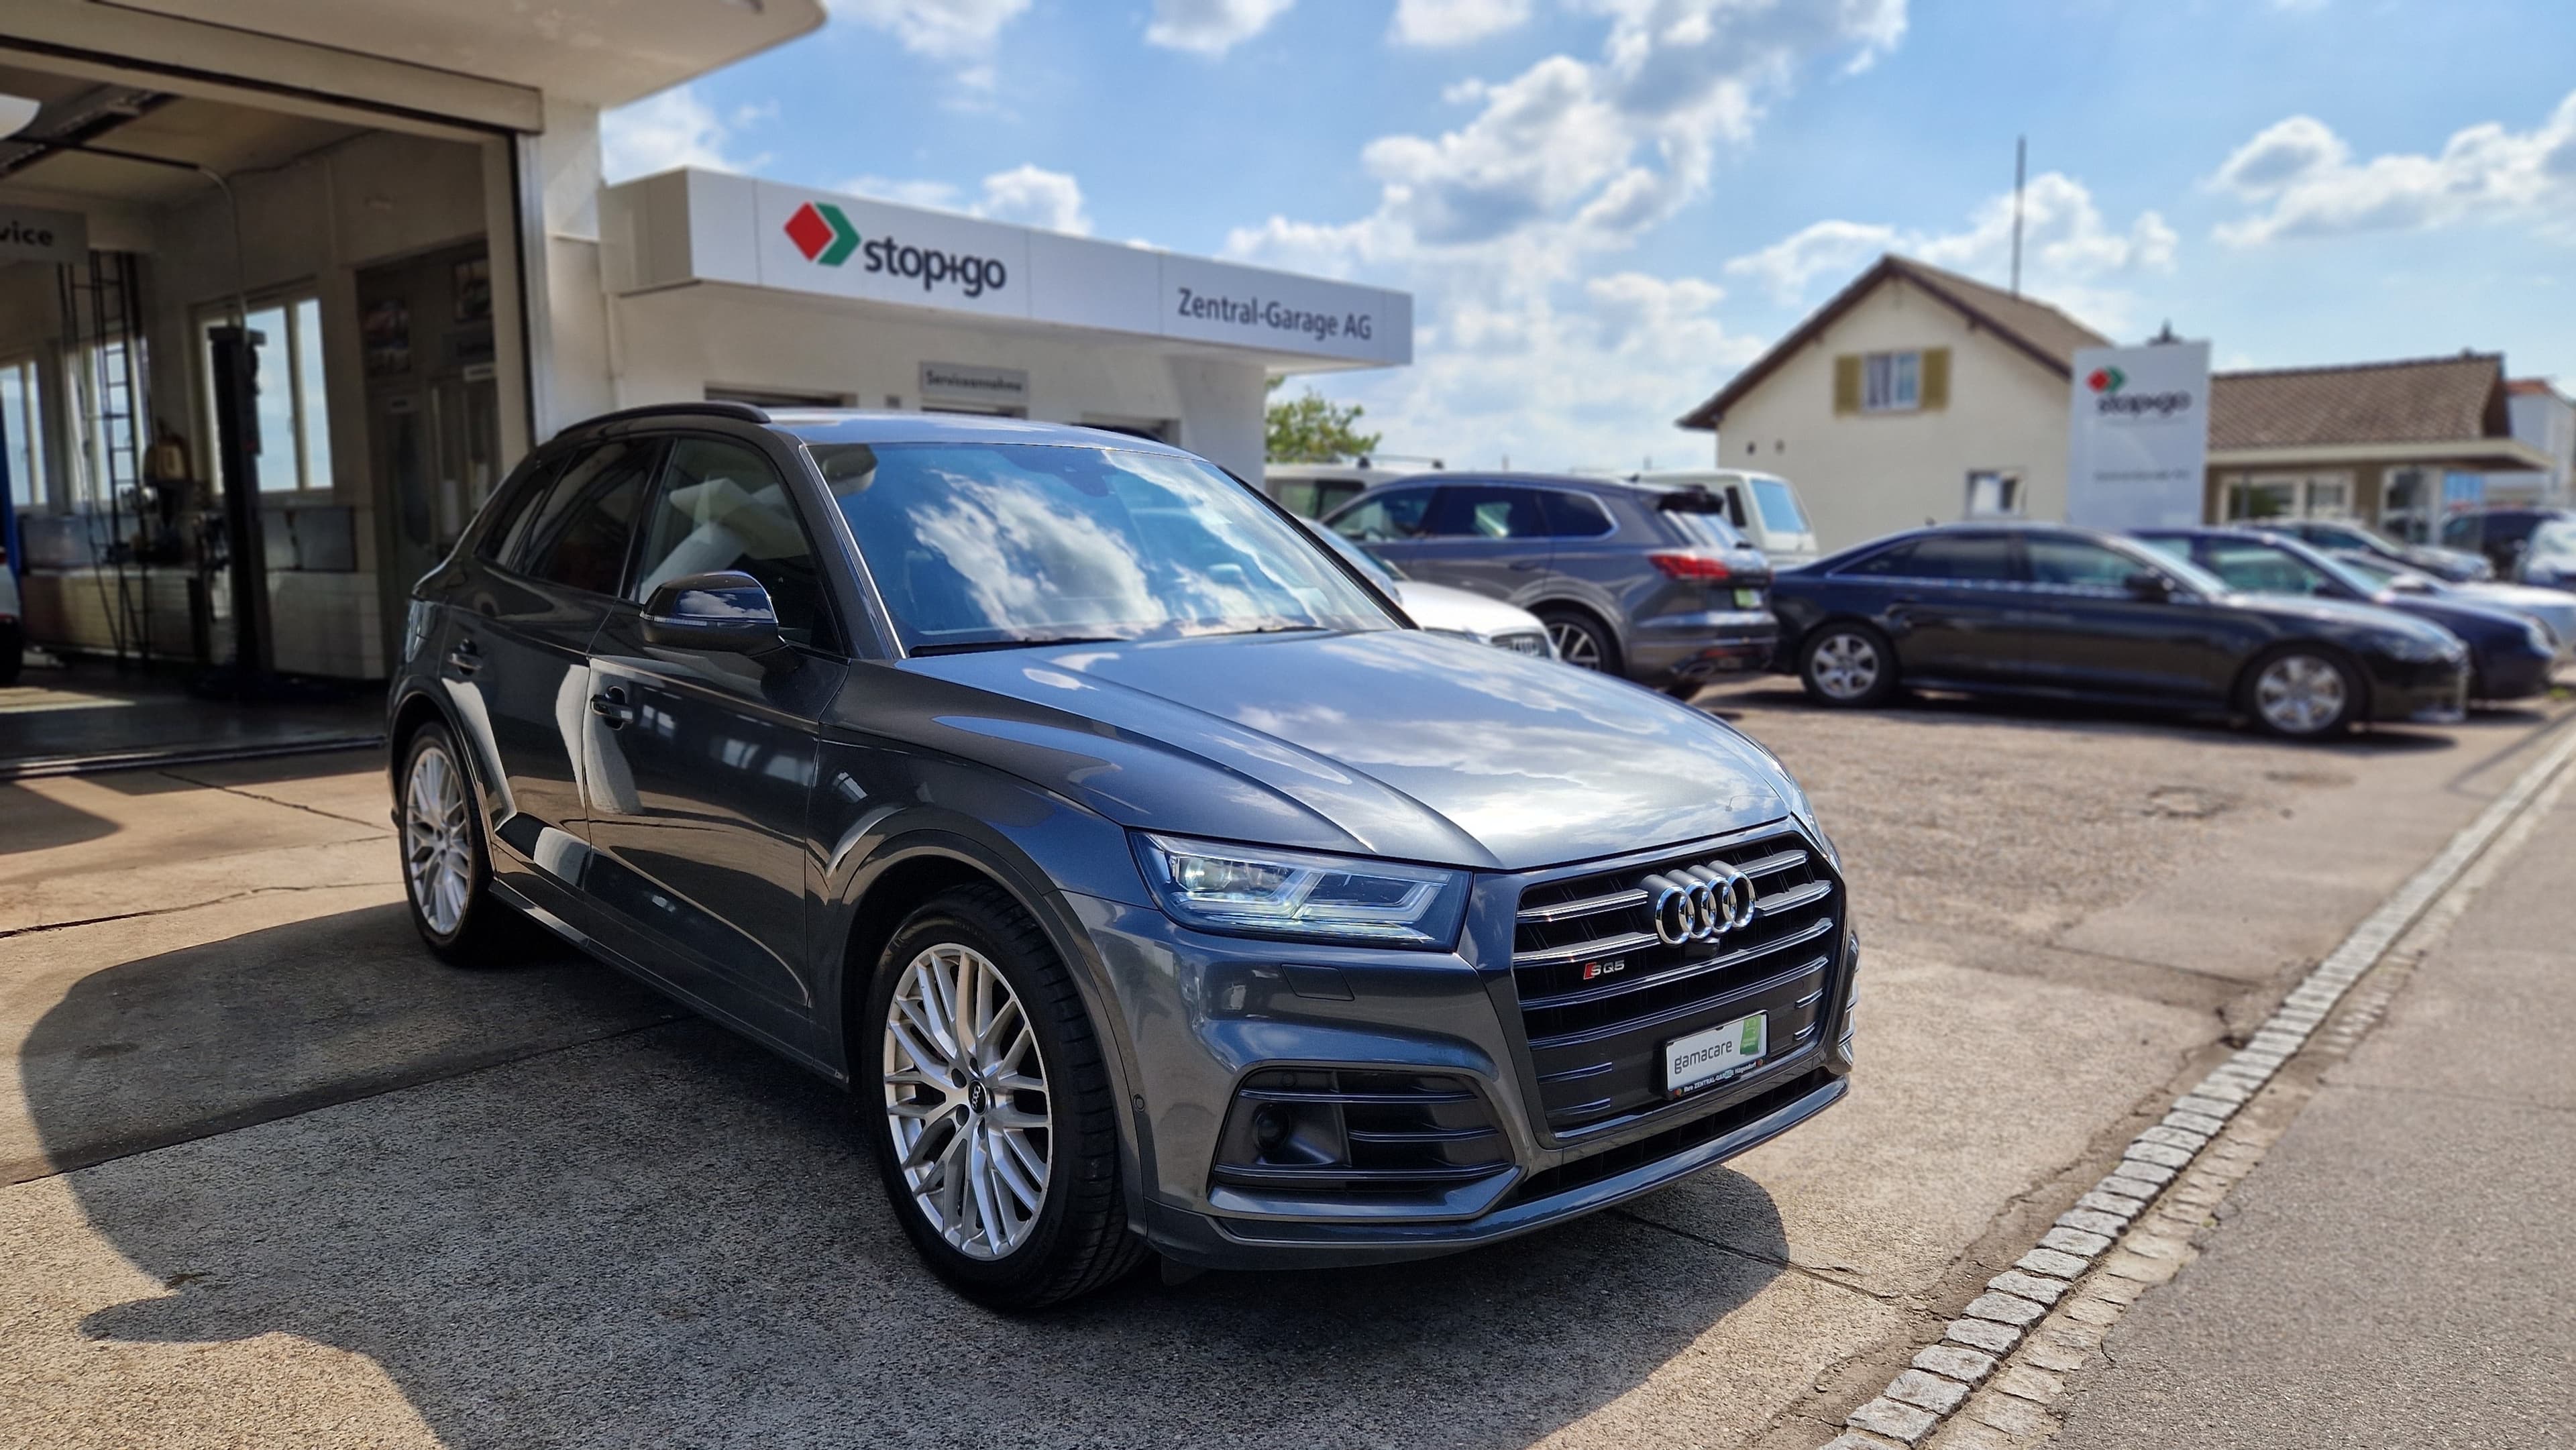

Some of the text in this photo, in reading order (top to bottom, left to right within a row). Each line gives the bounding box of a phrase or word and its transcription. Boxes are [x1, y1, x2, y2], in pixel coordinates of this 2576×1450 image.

[863, 236, 1007, 298] stop+go
[1178, 287, 1373, 341] Zentral-Garage AG
[1591, 960, 1625, 976] SQ5
[1674, 1040, 1733, 1074] gamacare
[1694, 1069, 1735, 1089] ZENTRAL-GARE
